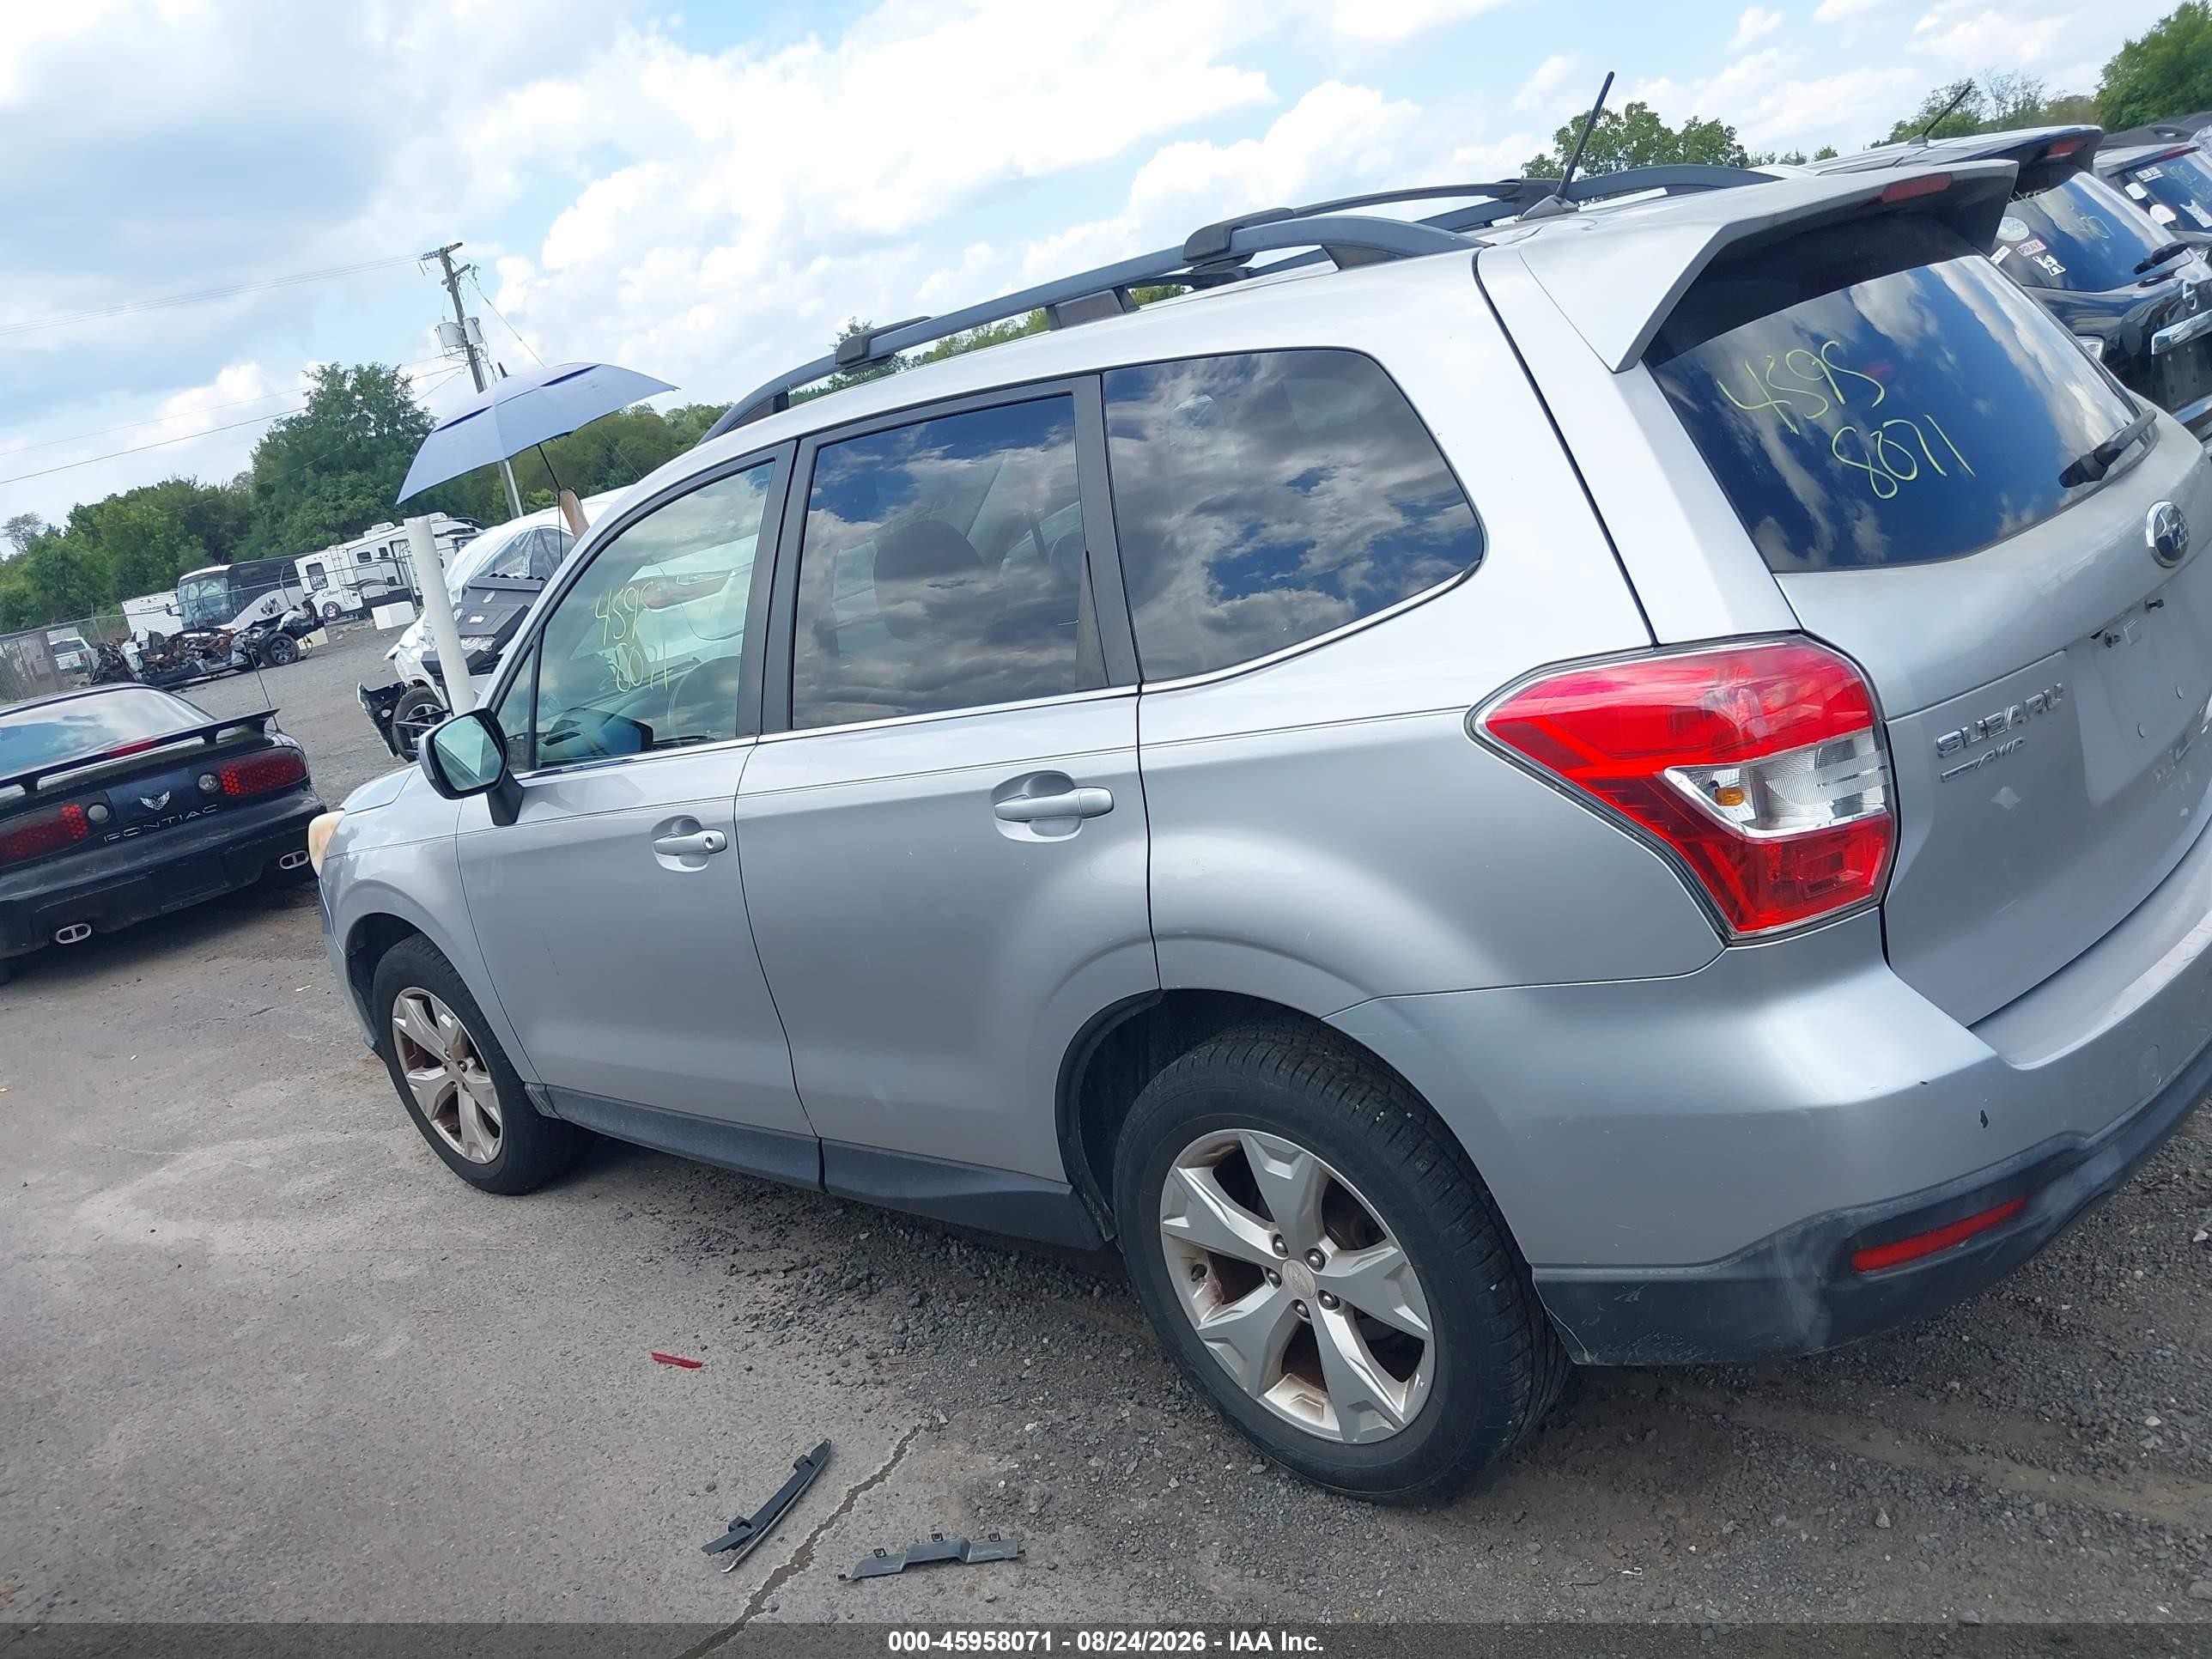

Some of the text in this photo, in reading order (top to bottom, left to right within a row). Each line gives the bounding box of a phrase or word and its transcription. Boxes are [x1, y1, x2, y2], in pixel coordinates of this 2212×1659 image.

[1717, 340, 1886, 435] 4595
[1832, 413, 1976, 499] 8071
[1935, 682, 2065, 757] SUBARU
[103, 804, 218, 842] PONTIAC
